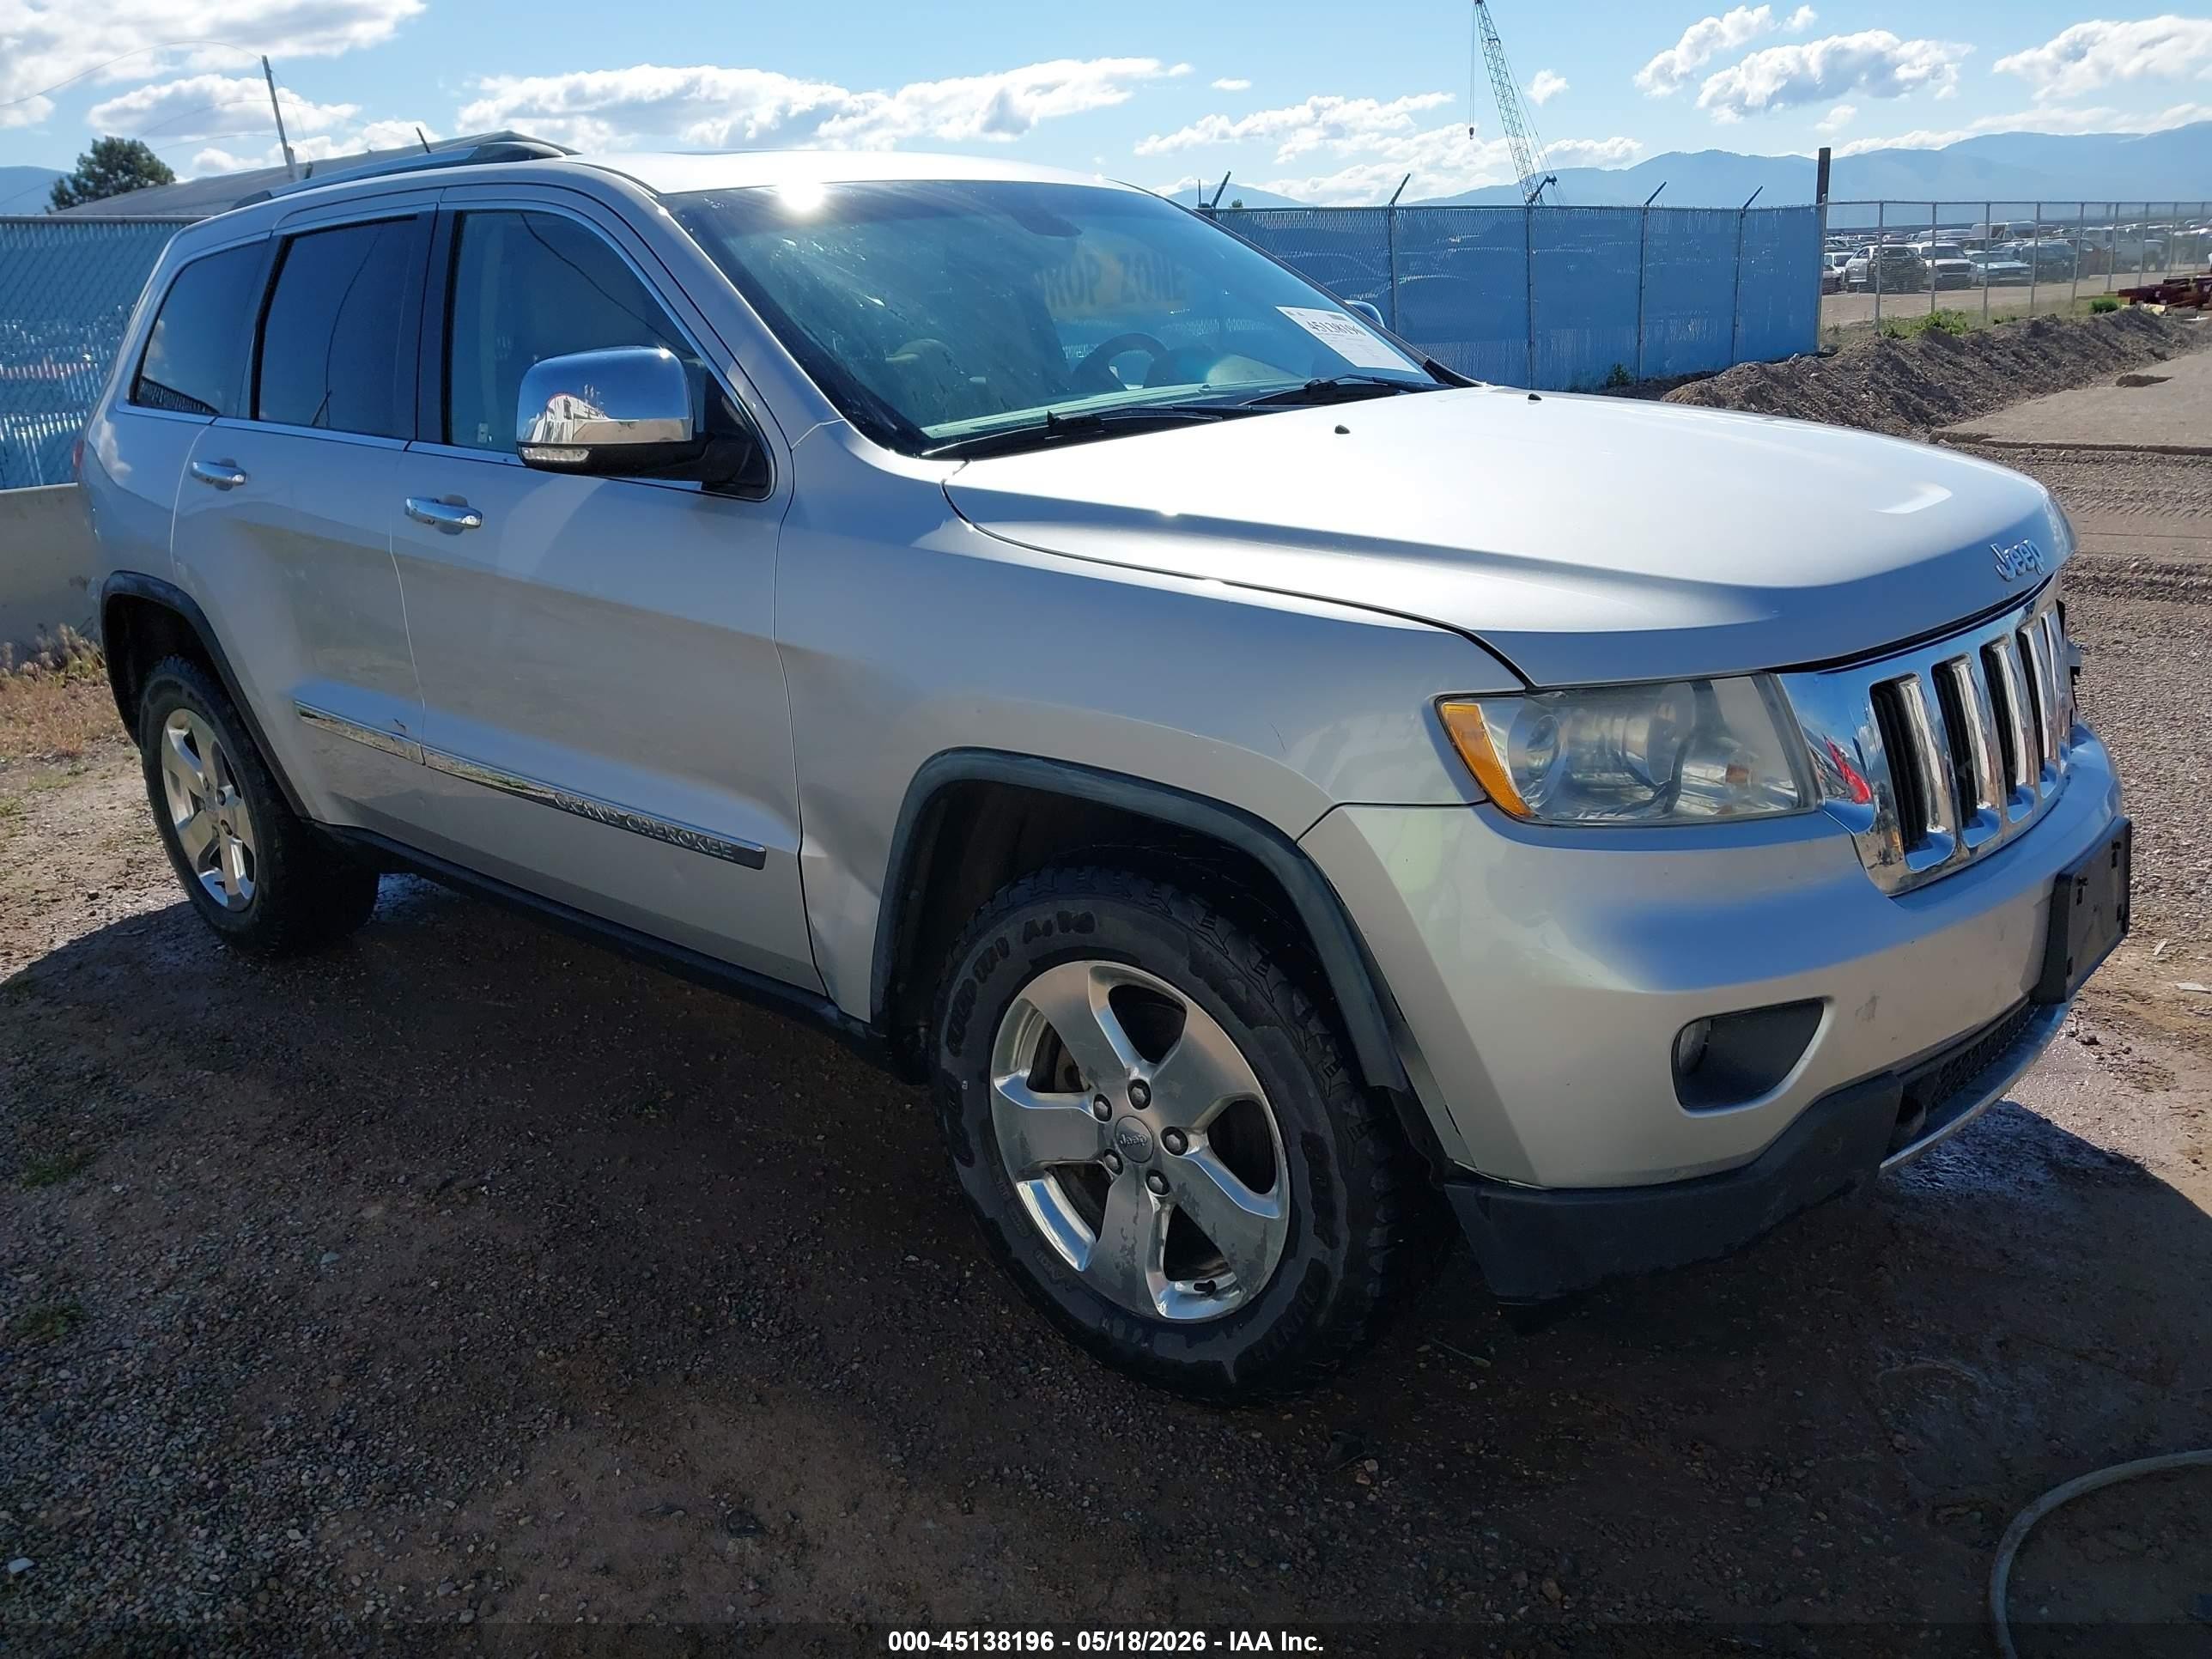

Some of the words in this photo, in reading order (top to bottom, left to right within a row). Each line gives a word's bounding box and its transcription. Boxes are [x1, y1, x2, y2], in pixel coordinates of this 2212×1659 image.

[1989, 539, 2045, 582] Jeep
[554, 792, 620, 825] GRAND
[626, 813, 735, 860] CHEROKEE
[1119, 1133, 1149, 1148] Jeep
